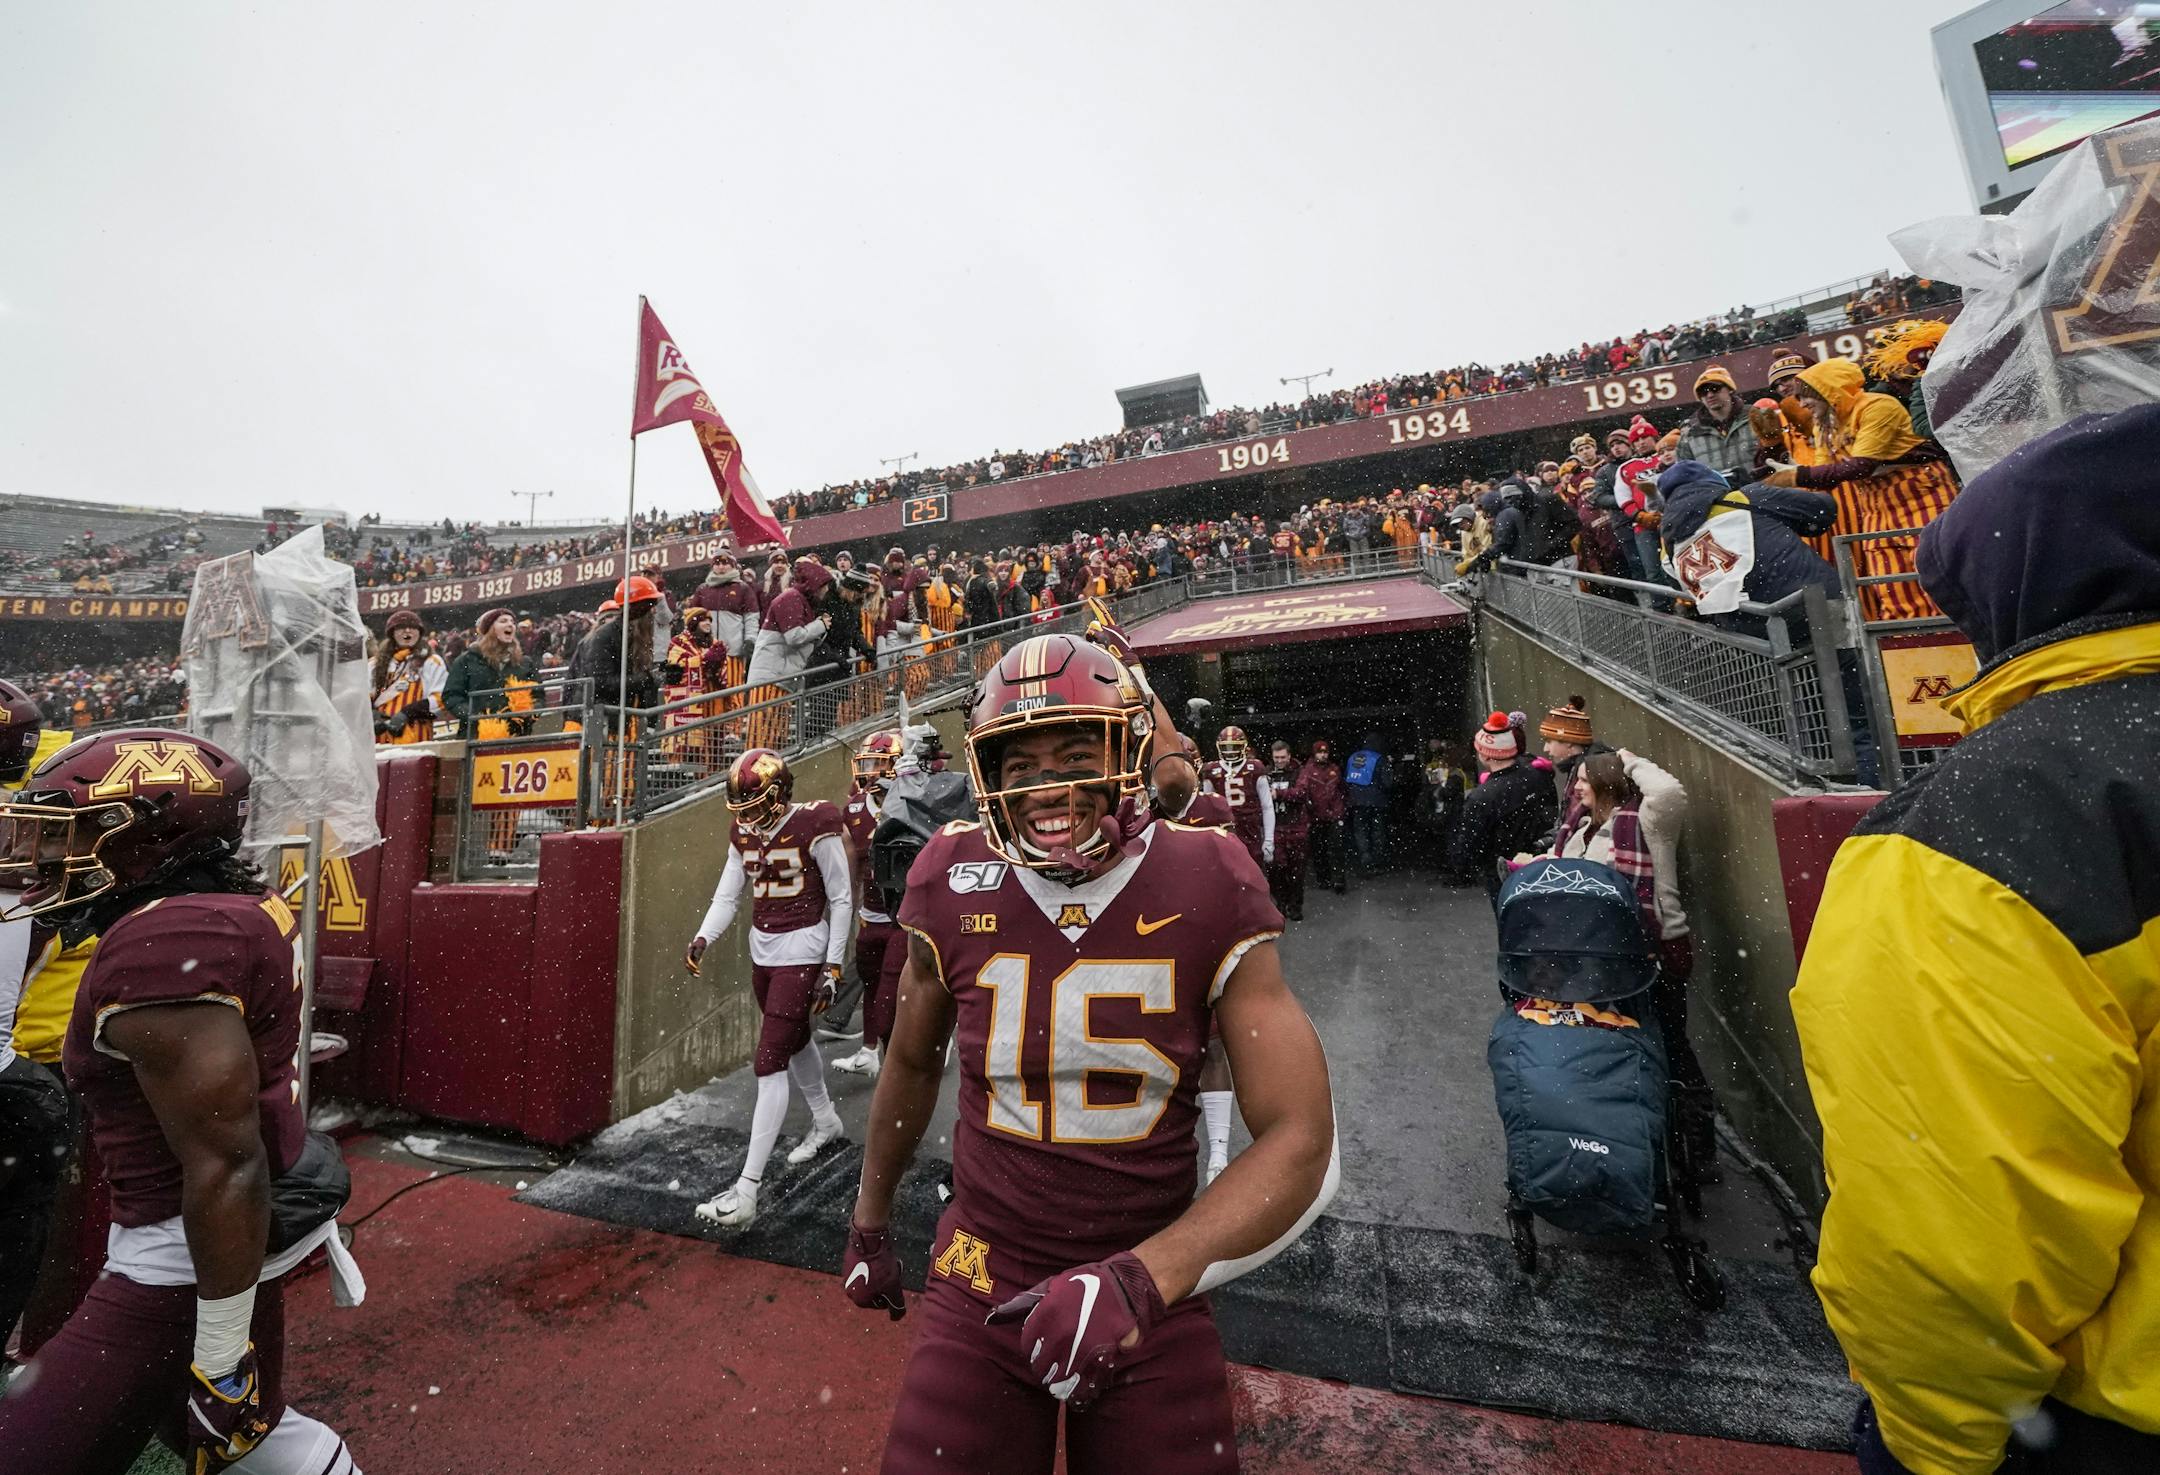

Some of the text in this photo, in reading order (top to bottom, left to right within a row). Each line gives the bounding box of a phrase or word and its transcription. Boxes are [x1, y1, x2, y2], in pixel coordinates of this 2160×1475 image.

[1217, 372, 1678, 472] 1904 1934 1935
[912, 498, 938, 521] 25
[370, 590, 410, 611] 1934
[423, 583, 463, 605] 1935
[477, 577, 513, 599] 1937
[525, 567, 563, 591] 1938
[576, 558, 615, 581] 1940
[630, 549, 669, 573] 1941
[89, 741, 223, 801] M
[499, 759, 549, 795] 126
[1225, 777, 1246, 807] 6
[948, 861, 1008, 894] 150
[1056, 905, 1092, 929] M
[976, 952, 1180, 1143] 16
[1569, 1137, 1609, 1154] WeGo
[935, 1228, 994, 1295] M
